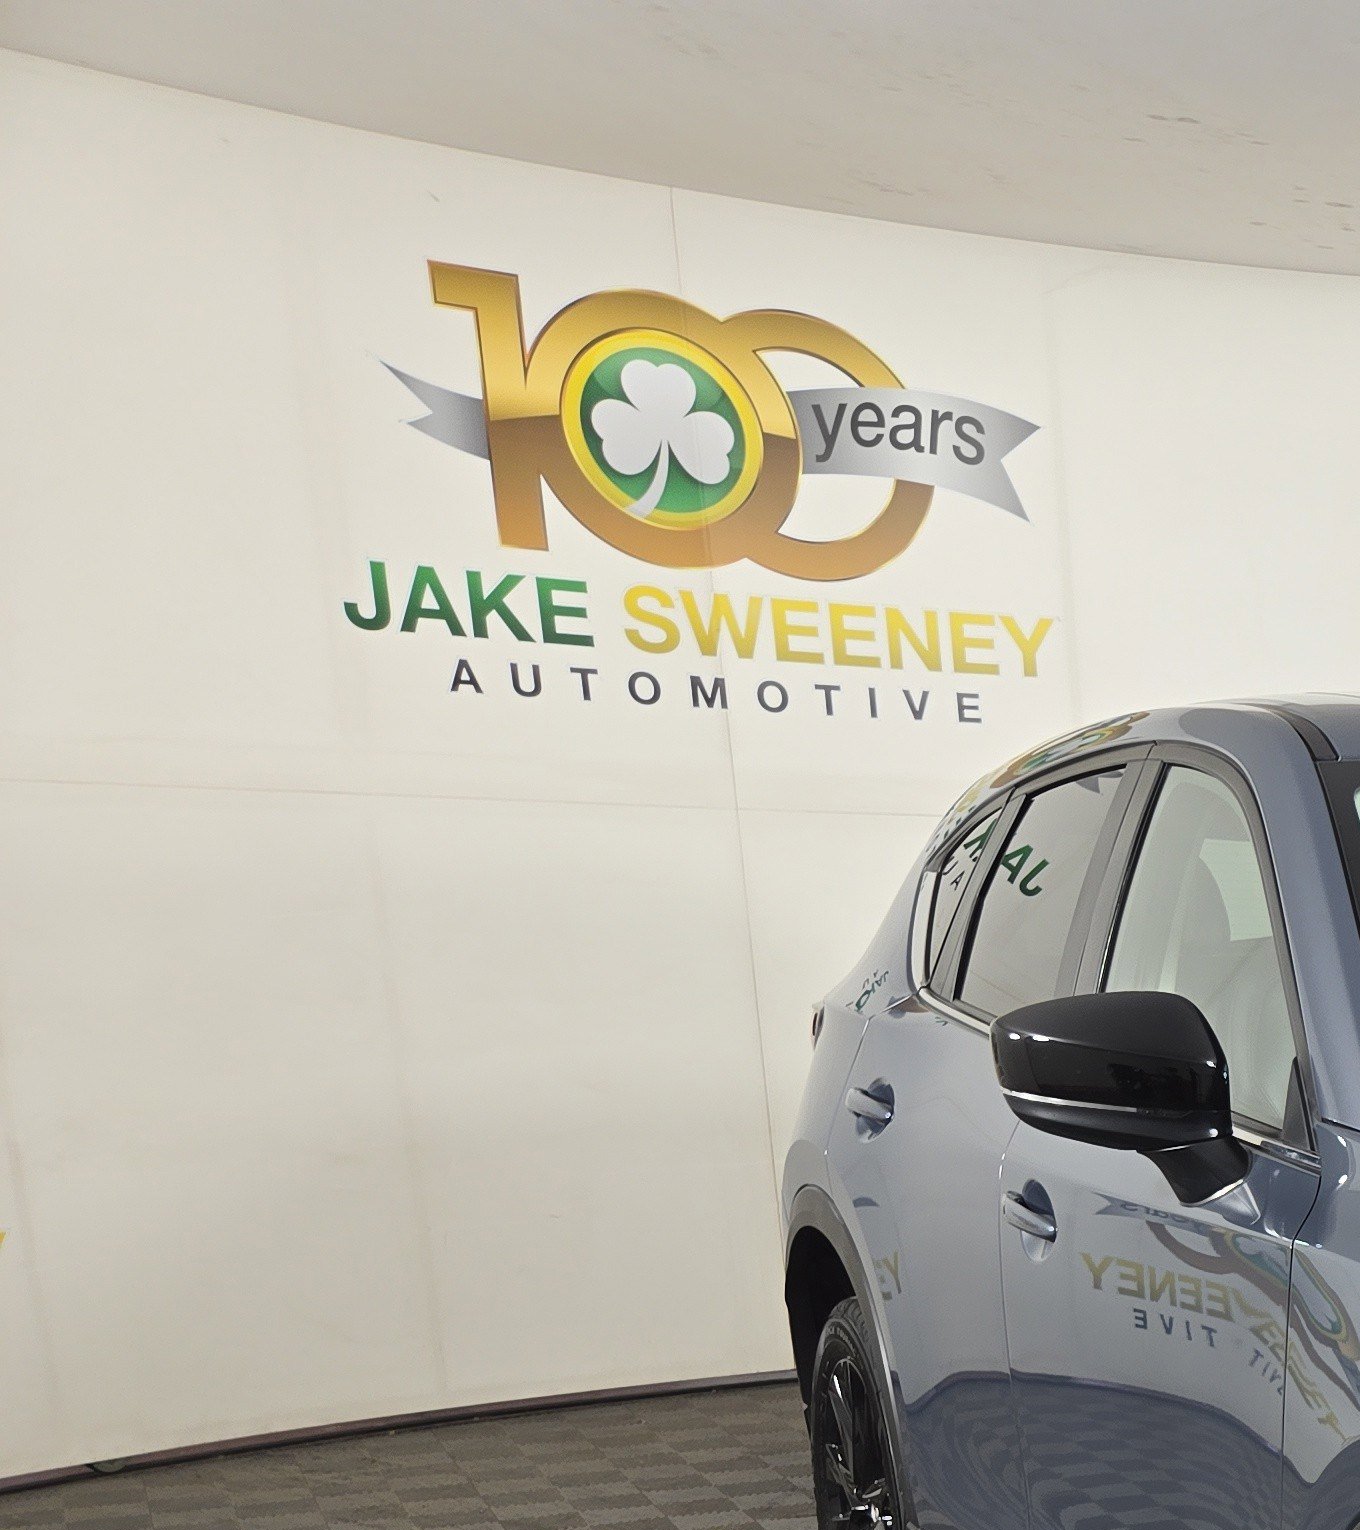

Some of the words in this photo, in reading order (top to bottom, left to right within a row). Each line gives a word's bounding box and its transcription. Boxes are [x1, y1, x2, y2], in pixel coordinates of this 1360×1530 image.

[427, 259, 935, 582] 100
[811, 400, 987, 467] years
[344, 560, 595, 647] JAKE
[624, 585, 1053, 678] SWEENEY
[450, 659, 982, 724] AUTOMOTIVE
